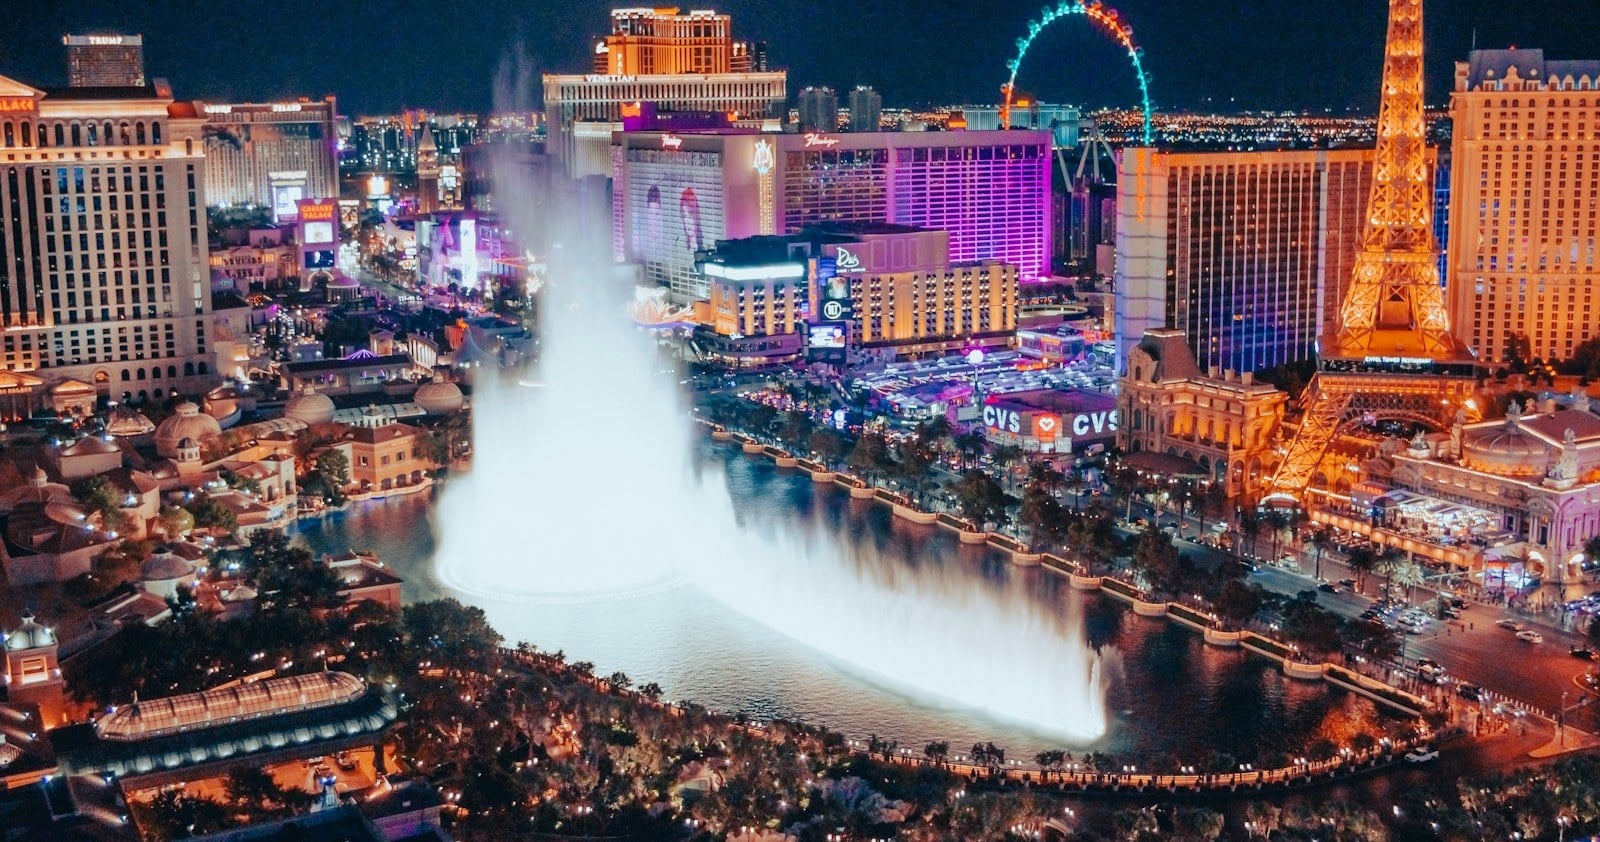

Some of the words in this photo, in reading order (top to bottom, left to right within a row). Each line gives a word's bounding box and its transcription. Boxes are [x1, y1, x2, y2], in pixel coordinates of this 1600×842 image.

[89, 36, 123, 45] TRUMP
[585, 74, 635, 82] VENETIAN
[0, 100, 34, 111] LACE
[804, 133, 839, 147] Flamingo
[302, 204, 333, 213] CAESARS
[303, 212, 332, 220] PALACE
[983, 405, 1020, 433] CVS
[1073, 410, 1118, 436] CVS
